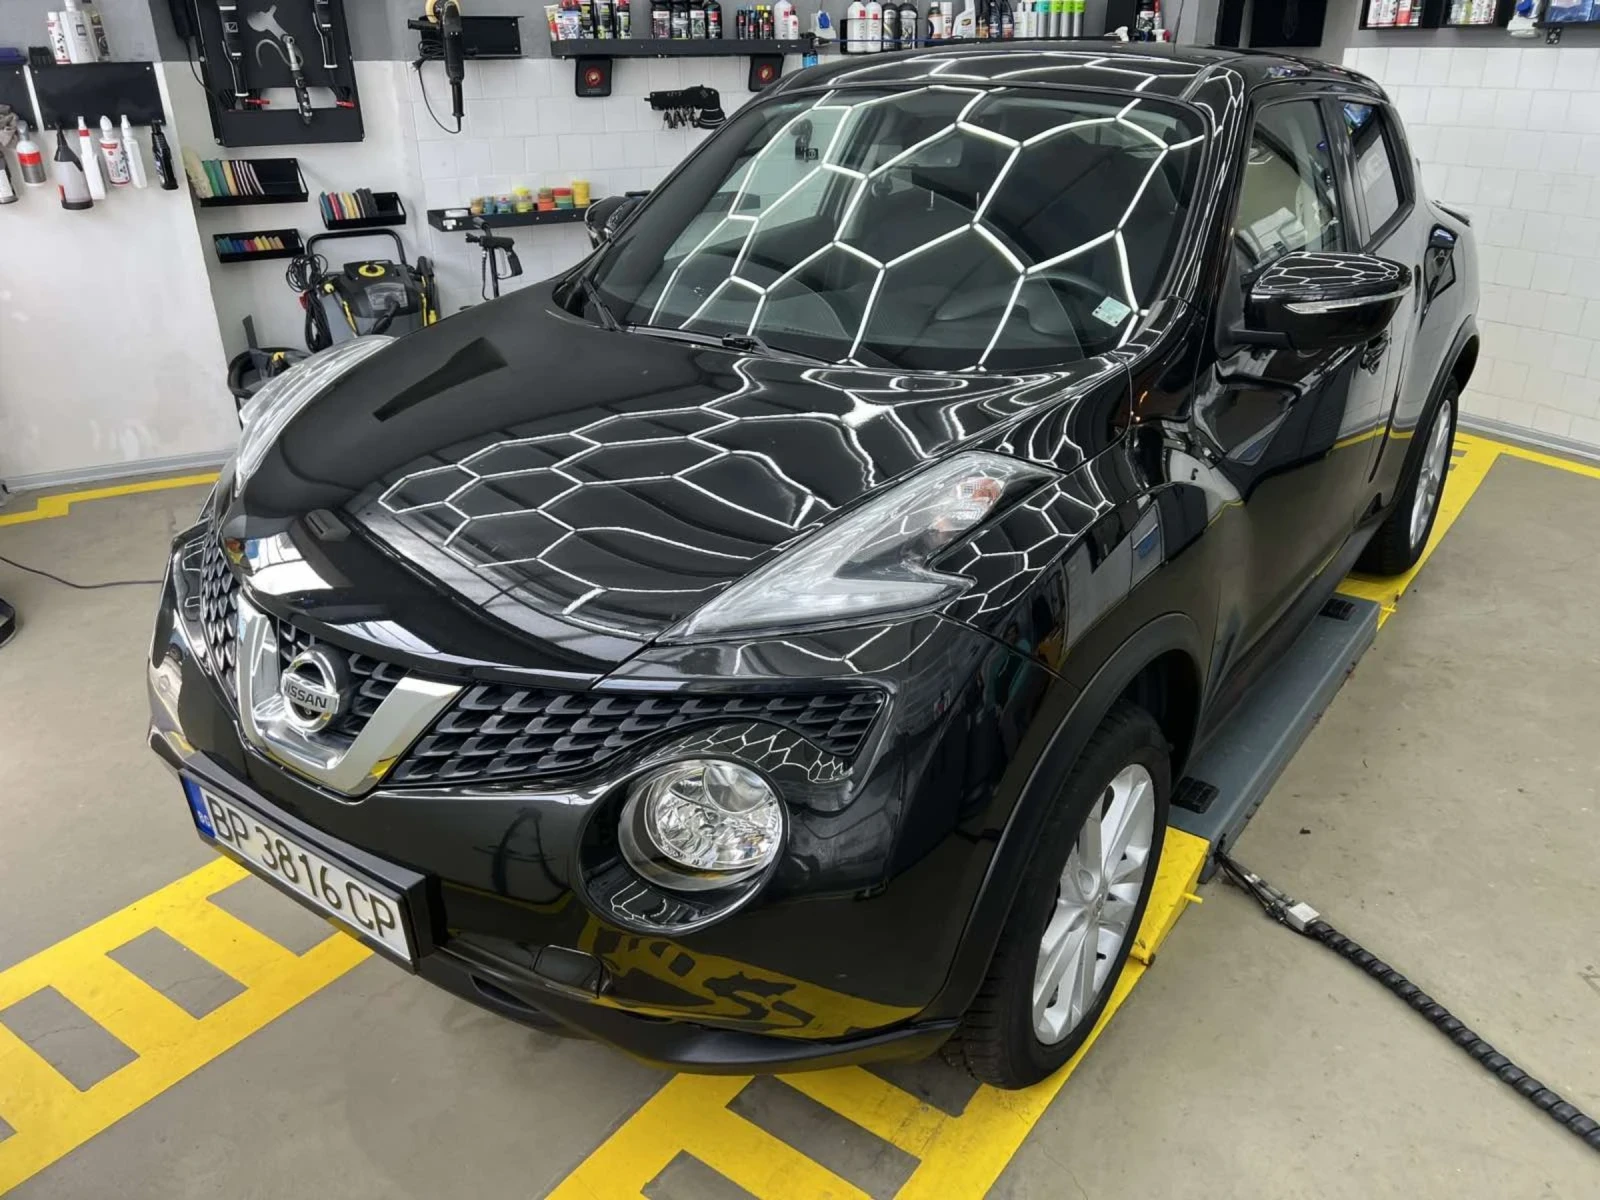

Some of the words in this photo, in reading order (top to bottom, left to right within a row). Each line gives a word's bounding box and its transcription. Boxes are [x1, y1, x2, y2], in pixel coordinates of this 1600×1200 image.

[285, 683, 327, 708] NISSAN
[197, 810, 211, 827] BG
[207, 796, 249, 848] BP
[255, 826, 342, 910] 3816
[345, 880, 396, 938] CP
